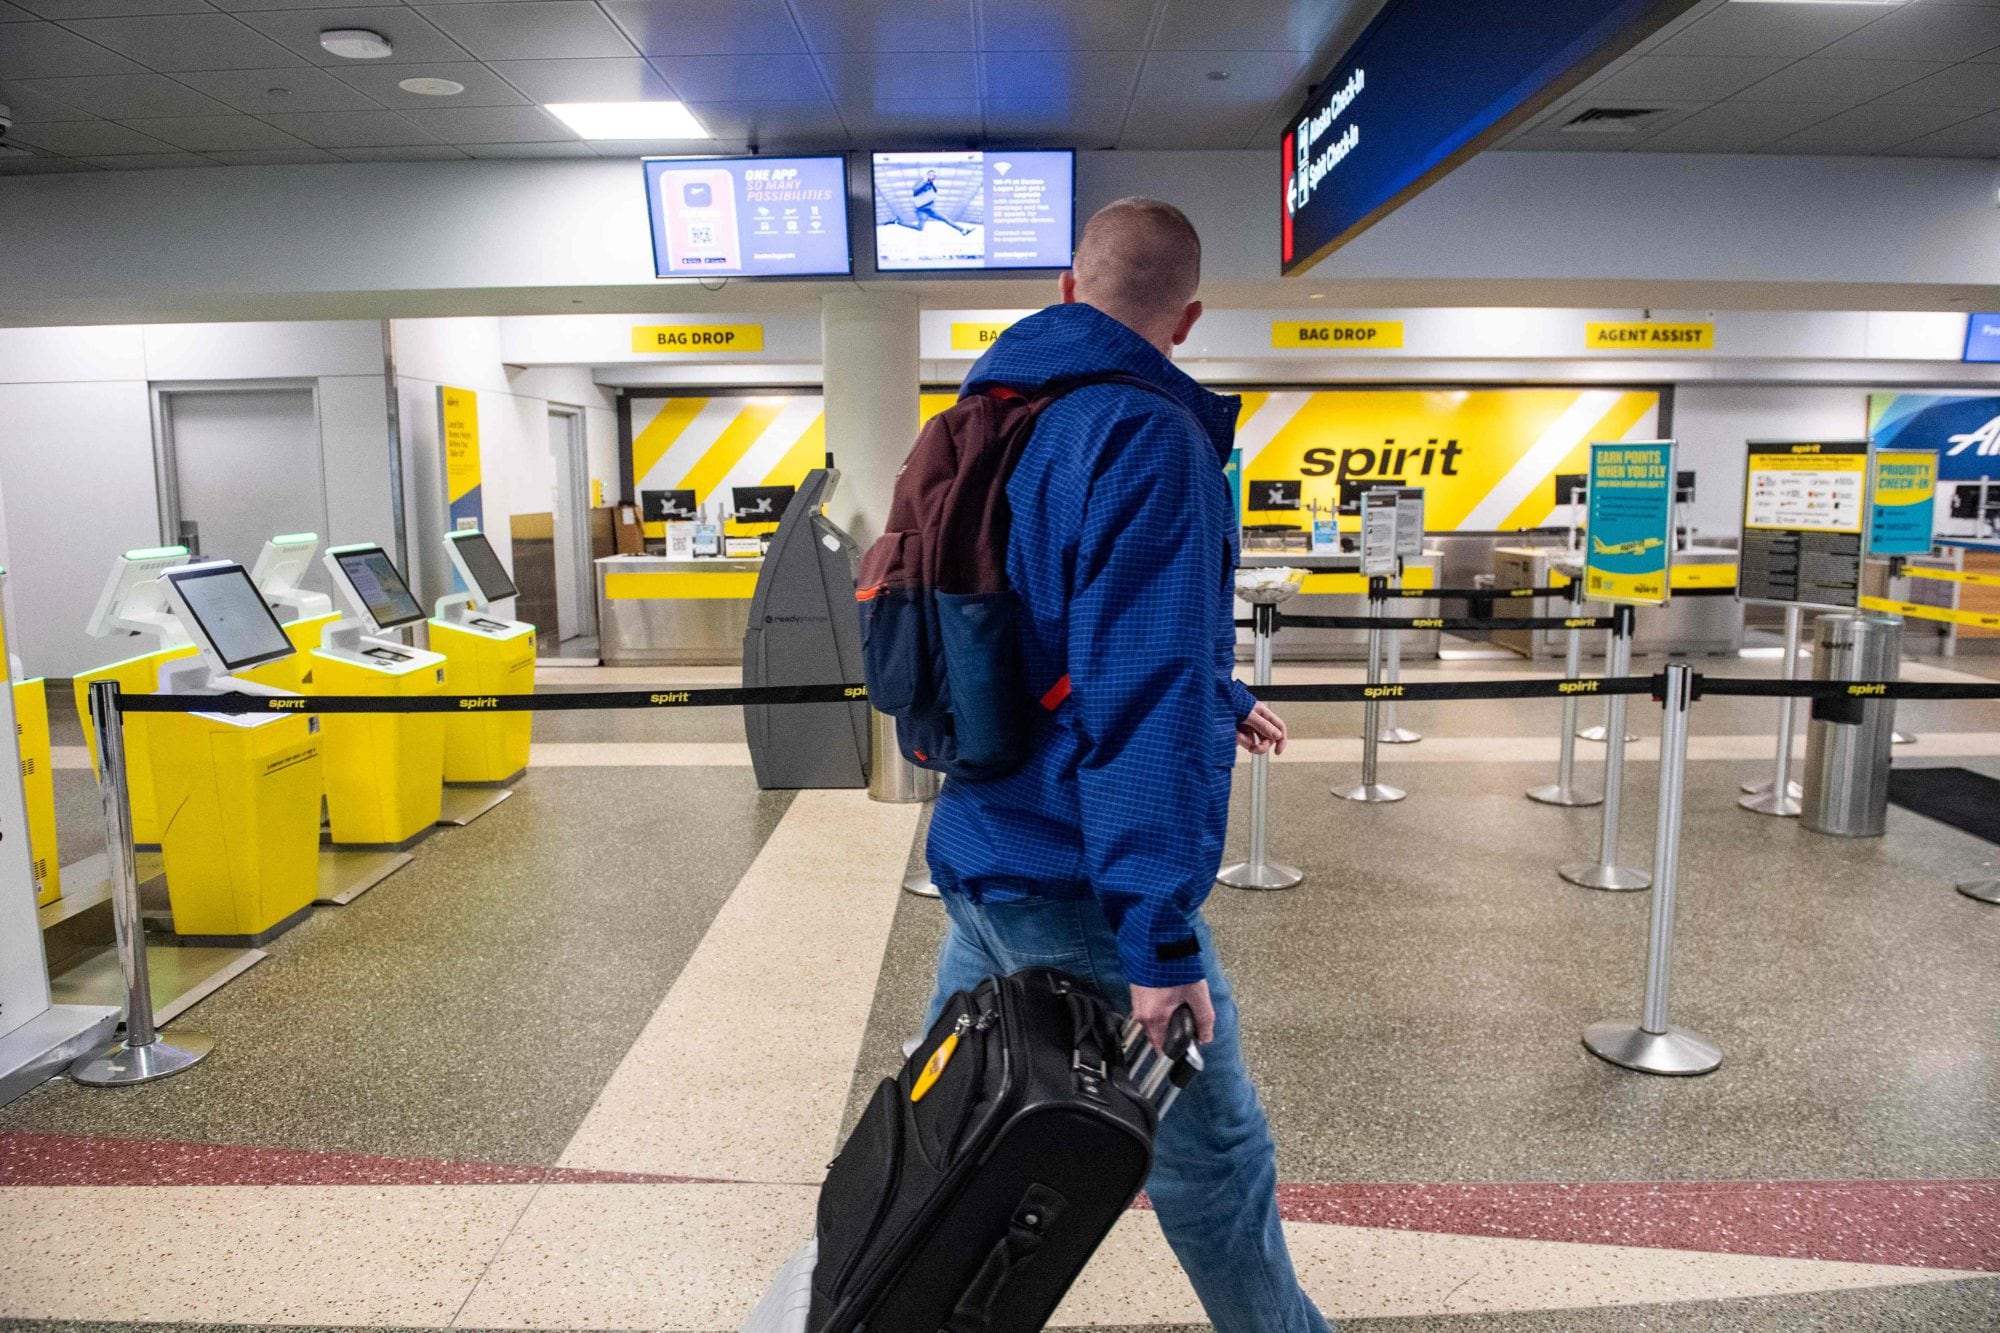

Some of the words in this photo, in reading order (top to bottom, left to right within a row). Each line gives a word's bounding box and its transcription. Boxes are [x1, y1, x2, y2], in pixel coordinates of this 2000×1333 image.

[744, 169, 770, 181] ONE
[771, 168, 798, 181] APP
[746, 180, 763, 191] SO
[765, 179, 802, 190] MANY
[746, 190, 833, 202] POSSIBILITIES
[658, 333, 687, 345] BAG
[692, 332, 735, 345] DROP
[979, 330, 999, 342] BA
[1299, 328, 1329, 341] BAG
[1333, 328, 1377, 341] DROP
[1598, 329, 1648, 341] AGENT
[1651, 329, 1703, 342] ASSIST
[1791, 444, 1821, 454] spirit
[1299, 438, 1463, 485] spirit
[1597, 451, 1623, 465] EARN
[1624, 450, 1661, 465] POINTS
[1597, 465, 1625, 478] WHEN
[1627, 465, 1648, 478] YOU
[1648, 465, 1667, 478] FLY
[1879, 464, 1930, 476] PRIORITY
[1412, 618, 1444, 628] spirit
[1564, 618, 1596, 628] spirit
[844, 685, 868, 698] spi
[1364, 686, 1404, 698] spirit
[1558, 681, 1599, 694] spirit
[1847, 684, 1887, 696] spirit
[459, 697, 498, 709] spirit
[650, 692, 689, 704] spirit
[269, 699, 305, 710] spirit
